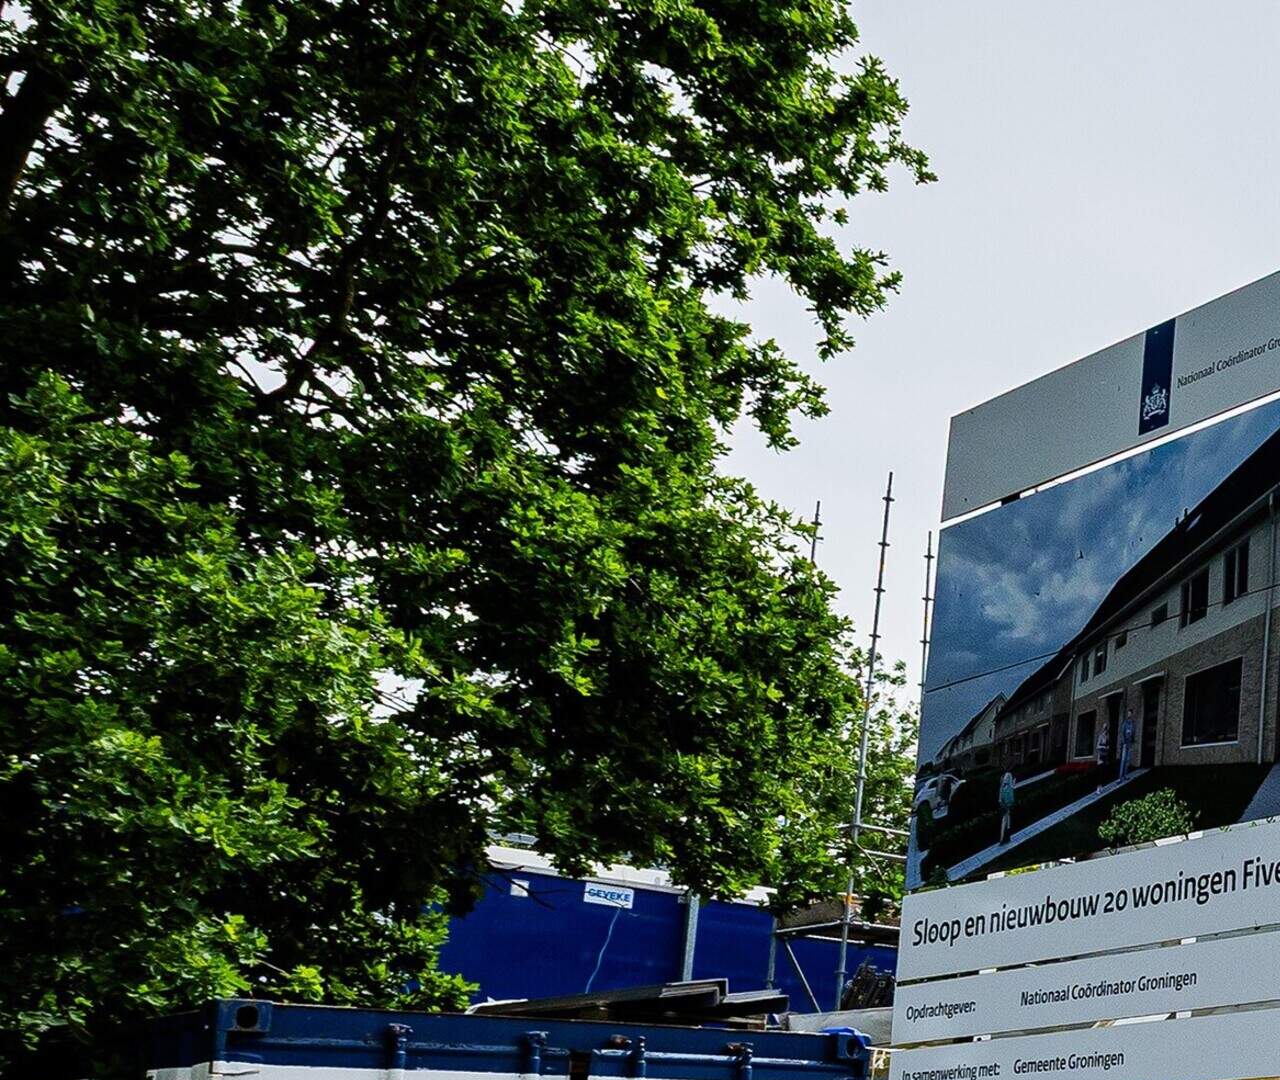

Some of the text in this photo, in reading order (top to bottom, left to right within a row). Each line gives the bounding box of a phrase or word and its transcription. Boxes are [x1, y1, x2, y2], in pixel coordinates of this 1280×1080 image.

[1177, 361, 1215, 388] Nationaal
[912, 918, 961, 947] Sloop
[965, 912, 985, 938] en
[989, 894, 1101, 934] nieuwbouw
[1104, 888, 1128, 914] 20
[1132, 867, 1237, 906] woningen
[906, 971, 1198, 1022] Opdrachtgever: Nationaal Coördinator Groningen
[978, 1063, 1001, 1079] met:
[1014, 1056, 1066, 1075] Gemeente
[1068, 1051, 1125, 1074] Groningen
